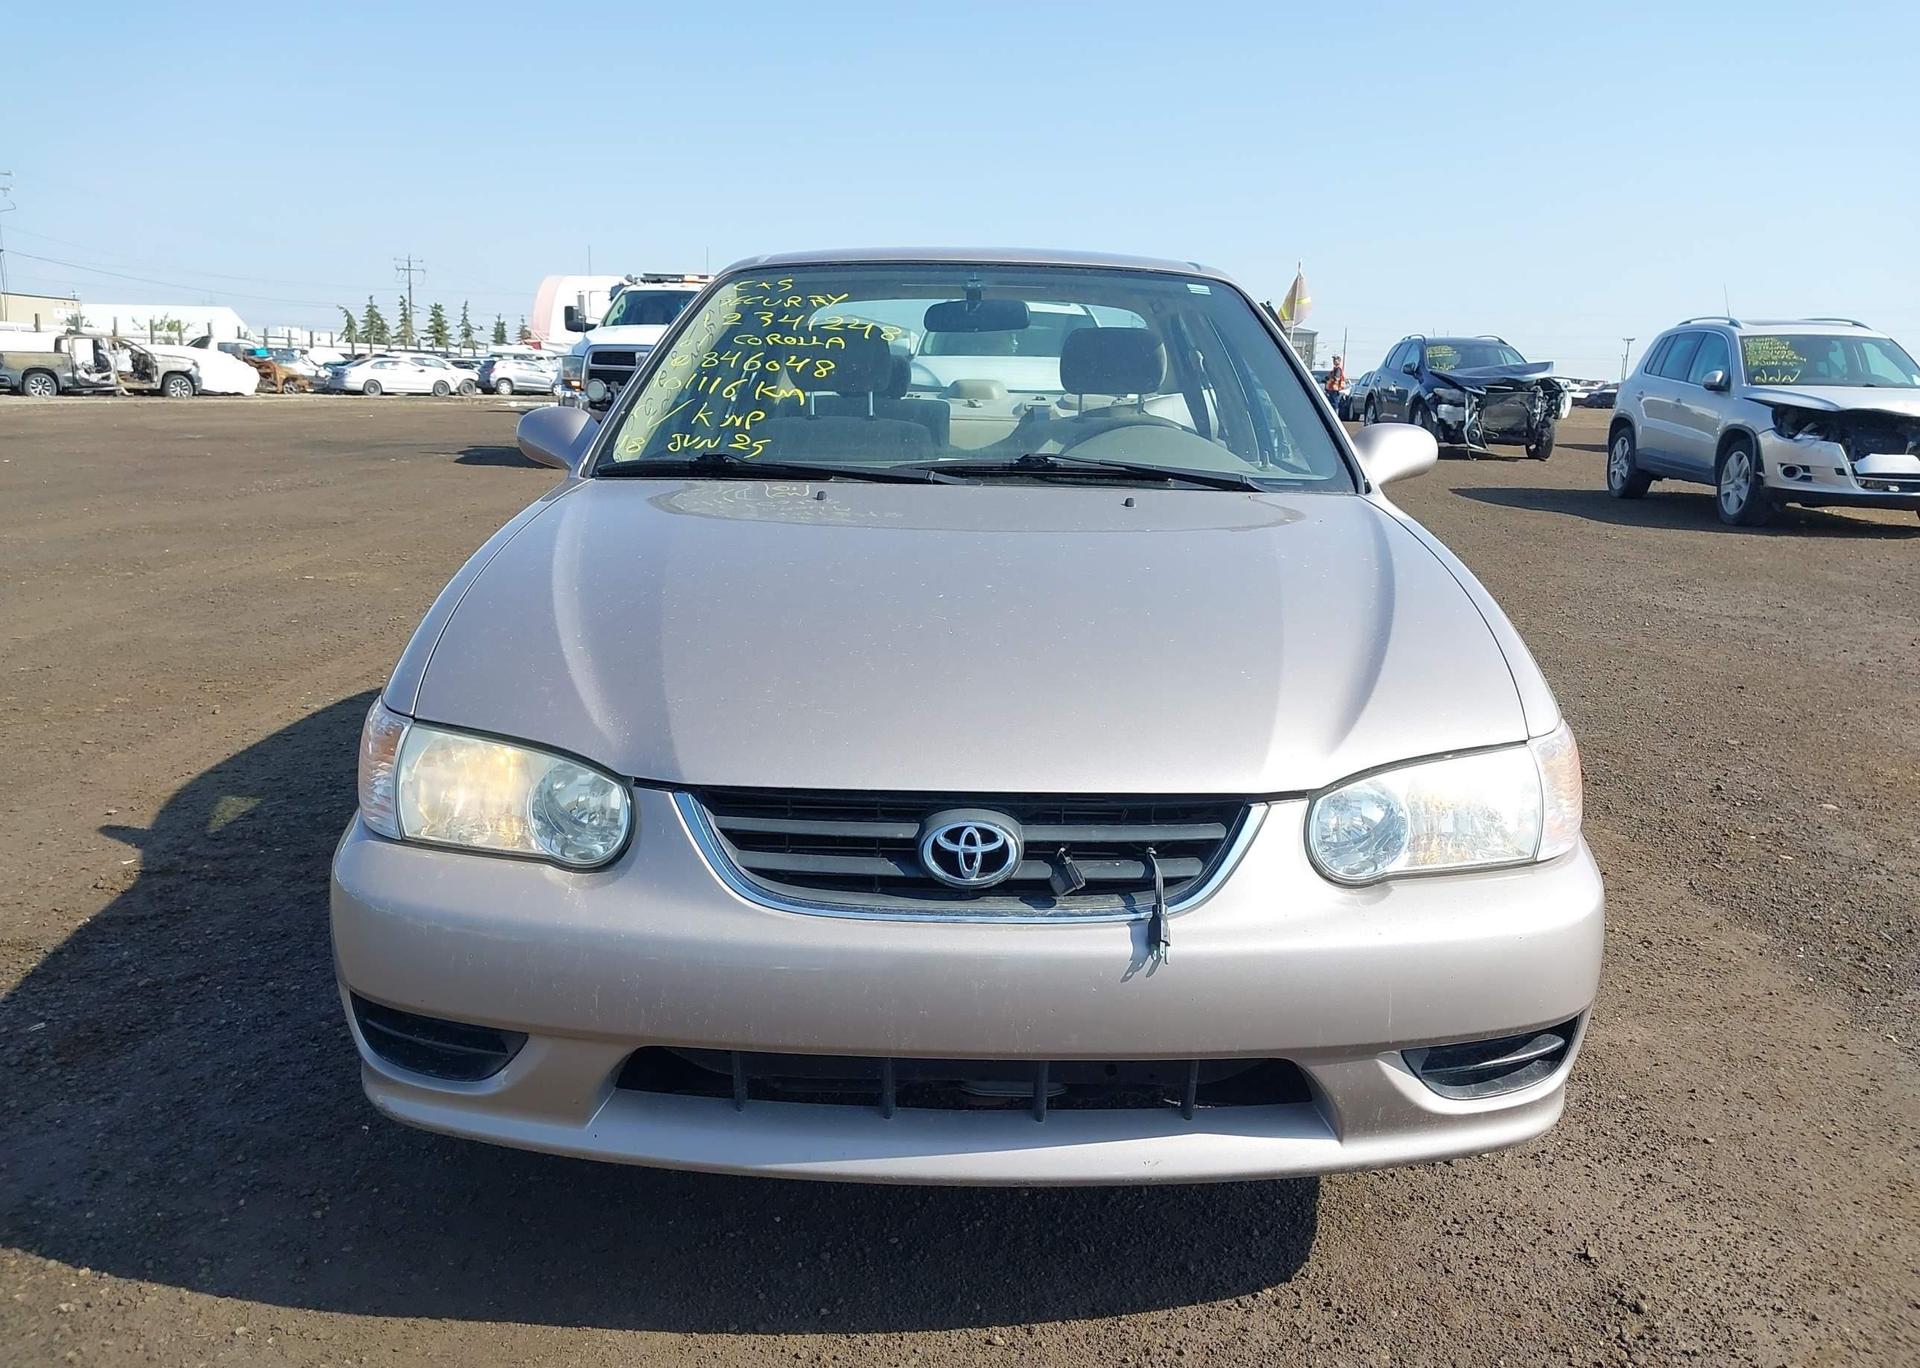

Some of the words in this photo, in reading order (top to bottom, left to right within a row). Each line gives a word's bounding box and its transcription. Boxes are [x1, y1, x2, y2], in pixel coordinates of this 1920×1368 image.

[733, 334, 846, 349] COROLLA
[667, 433, 721, 451] JUN
[728, 434, 772, 459] 25
